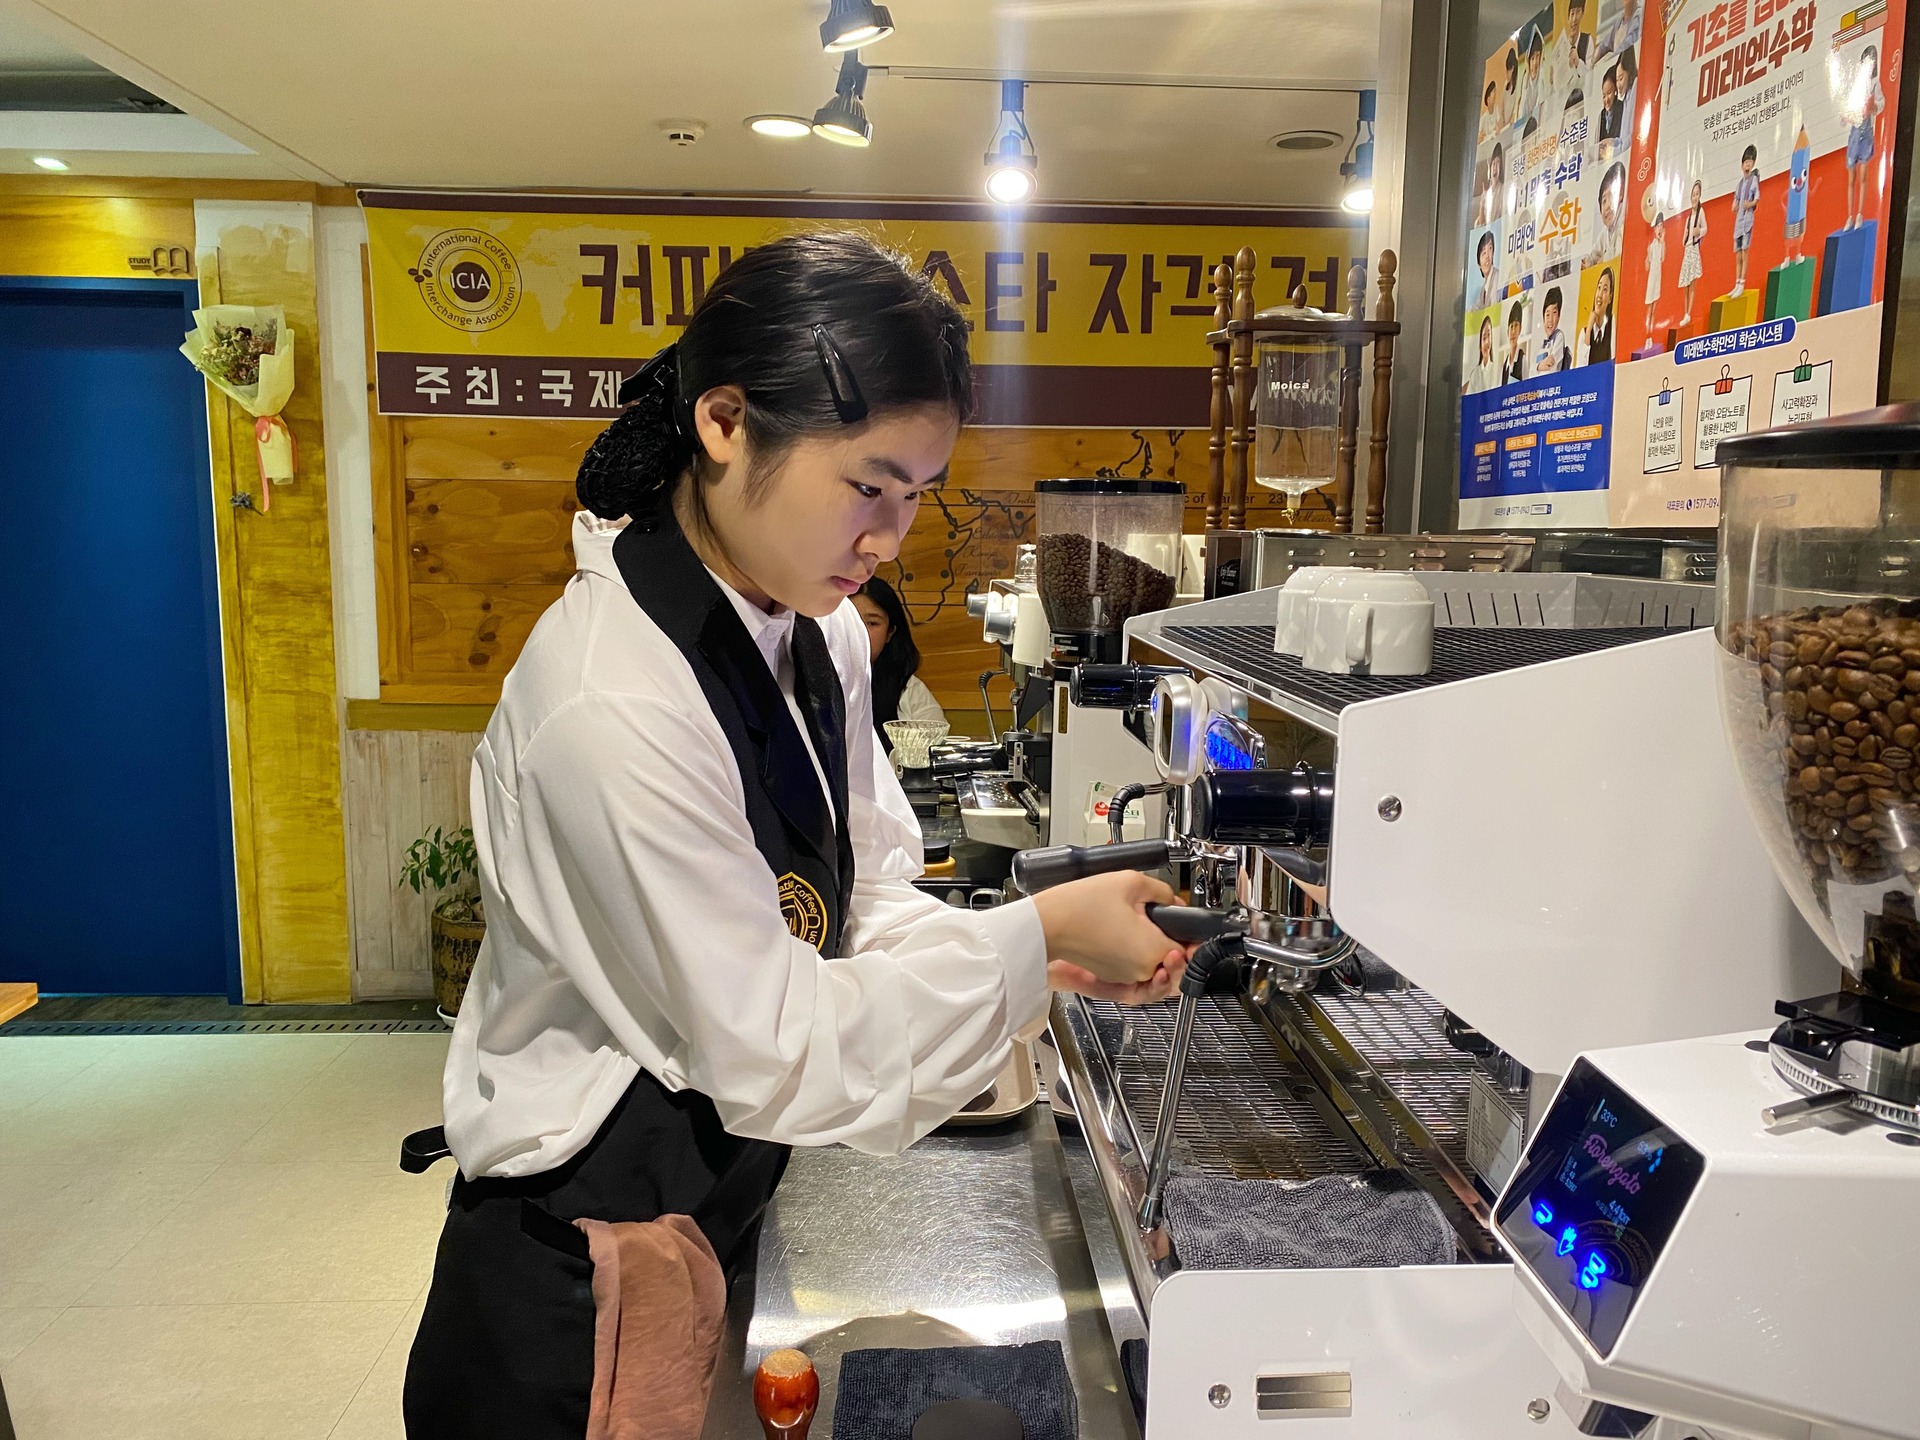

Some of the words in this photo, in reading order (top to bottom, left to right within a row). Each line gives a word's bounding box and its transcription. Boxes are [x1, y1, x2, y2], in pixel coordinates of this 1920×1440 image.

[1686, 0, 1749, 62] 기초를
[1697, 0, 1817, 107] 미래엔수학
[1703, 111, 1722, 131] 맞춤형
[1723, 92, 1762, 121] 교육콘텐츠를
[1764, 84, 1776, 103] 통해
[1777, 80, 1785, 94] 내
[1785, 69, 1804, 90] 아이의
[1560, 116, 1589, 148] 수준별
[1712, 112, 1758, 142] 자기주도학습이
[1555, 152, 1582, 190] 수학
[1508, 219, 1536, 258] 미래엔
[1538, 197, 1582, 255] 수학
[424, 234, 482, 268] International
[484, 239, 512, 270] Coffee
[450, 271, 491, 290] ICIA
[425, 282, 473, 326] Interchange
[475, 286, 516, 325] Association
[1683, 333, 1737, 360] 미래엔수학만의
[1739, 322, 1784, 349] 학습시스템
[1270, 380, 1310, 391] Moica
[1781, 394, 1818, 410] 사고력확장과
[1716, 404, 1746, 419] 오답노트를
[1720, 420, 1738, 434] 나만의
[794, 884, 818, 914] Coffee
